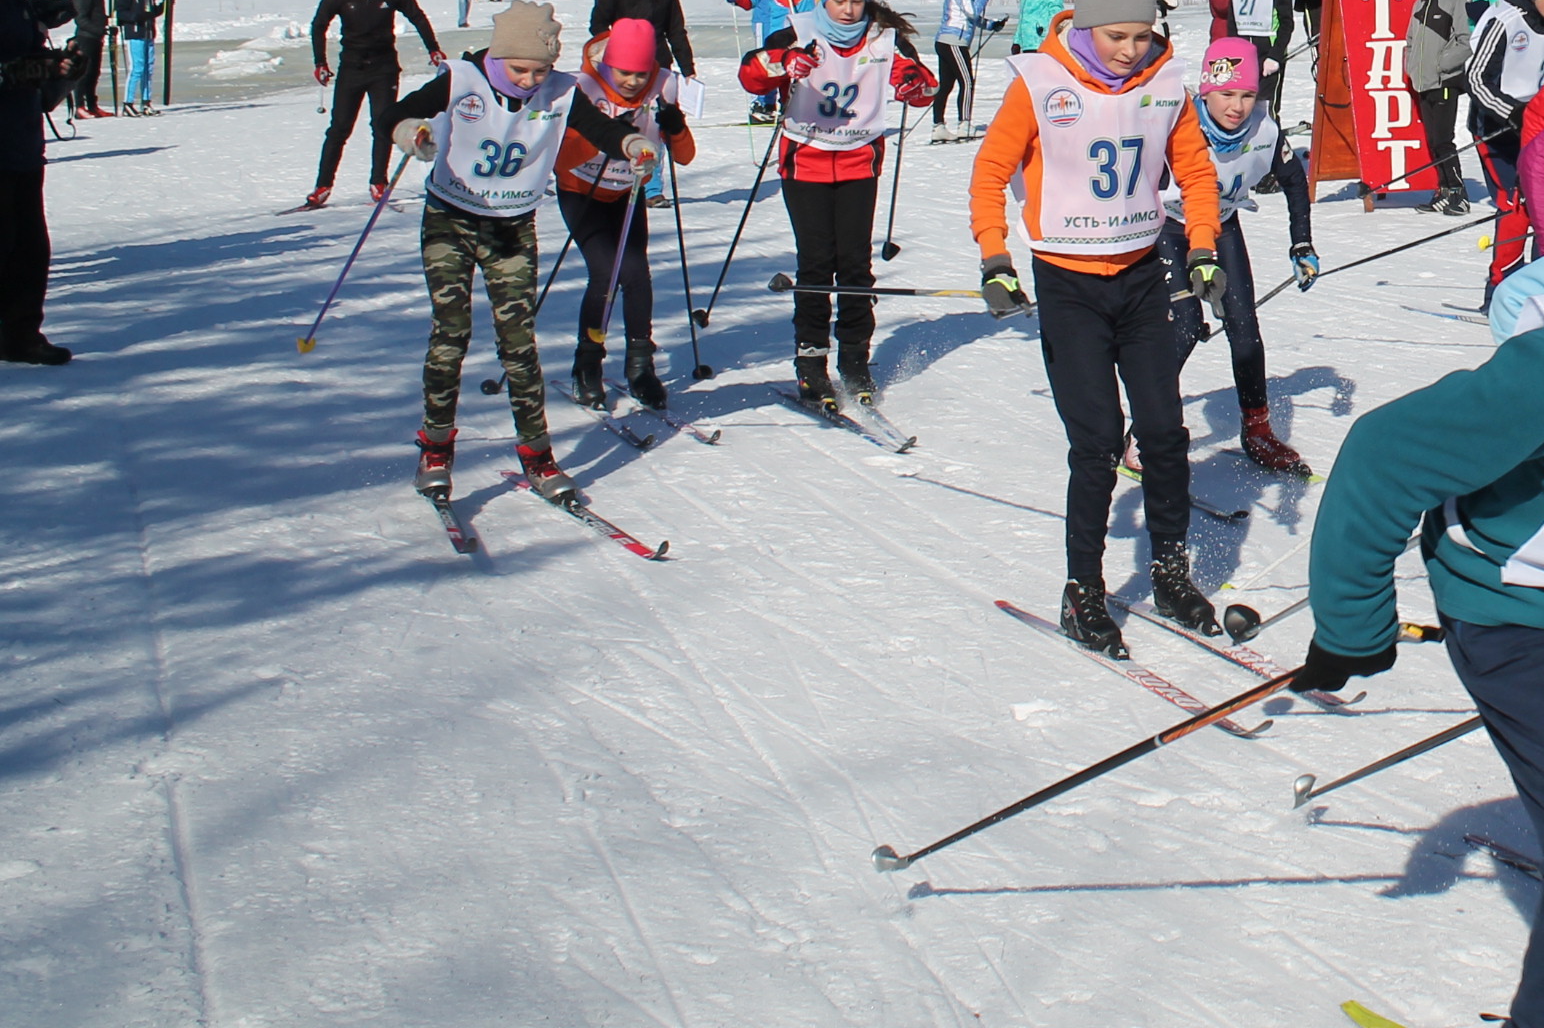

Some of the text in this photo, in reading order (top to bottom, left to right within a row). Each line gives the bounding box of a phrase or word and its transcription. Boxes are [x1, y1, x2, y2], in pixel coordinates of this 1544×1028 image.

[818, 81, 860, 118] 32
[1155, 99, 1181, 108] ИЛИМ
[473, 138, 528, 179] 36
[1088, 136, 1145, 201] 37
[1064, 210, 1160, 229] УСТЬ-ИЛИМСК
